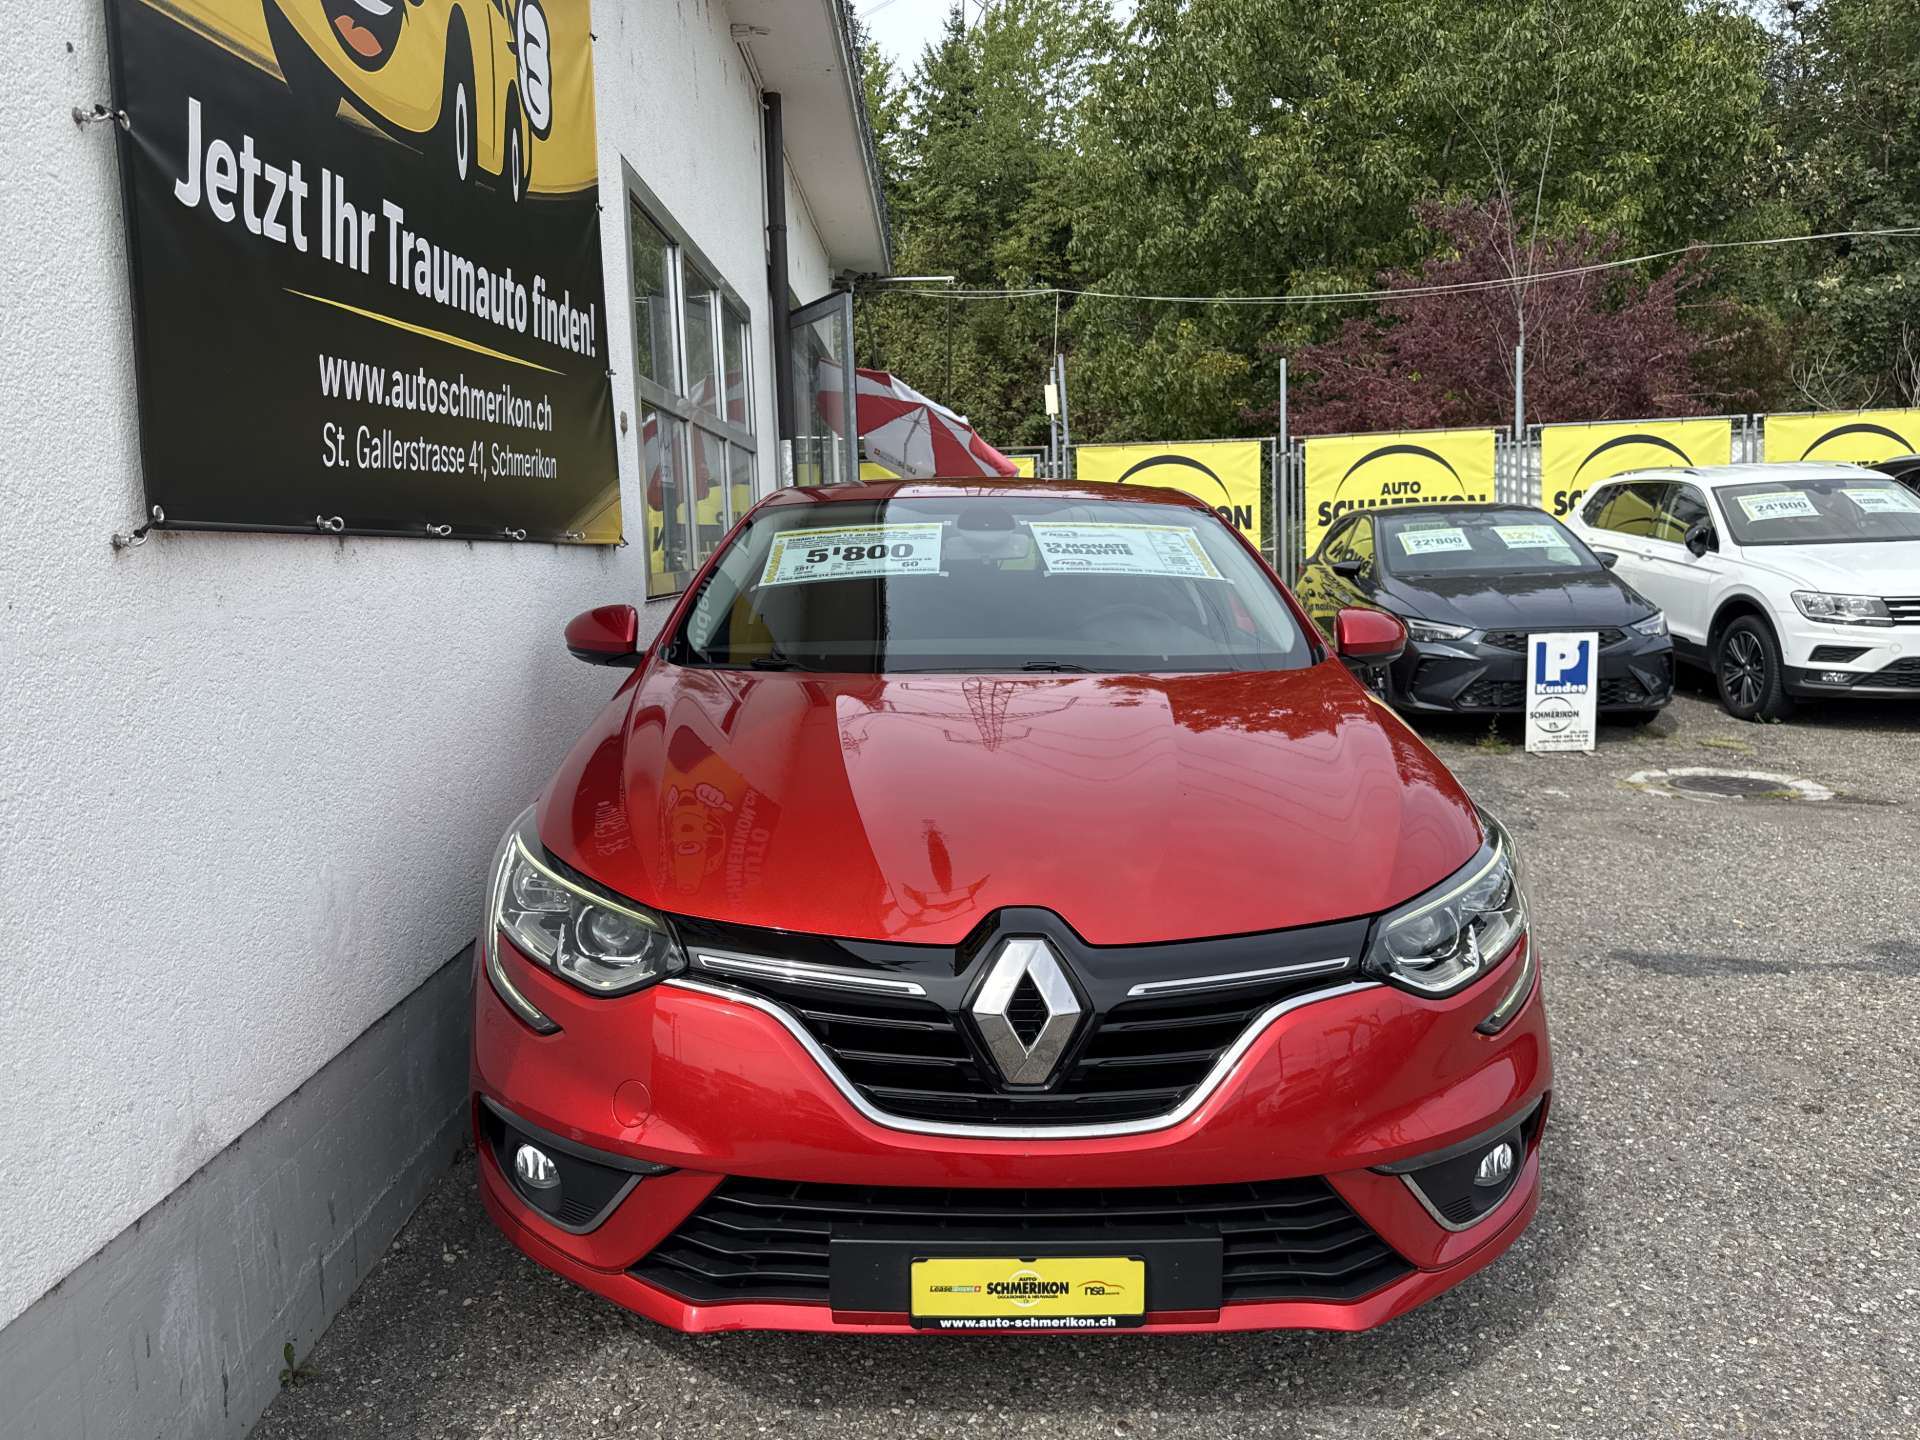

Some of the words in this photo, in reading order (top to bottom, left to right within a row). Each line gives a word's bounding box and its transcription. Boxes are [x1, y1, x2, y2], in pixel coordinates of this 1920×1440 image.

[174, 97, 309, 252] Jetzt
[321, 168, 375, 275] Ihr
[382, 199, 527, 333] Traumauto
[532, 274, 596, 358] finden!
[318, 353, 553, 432] www.autoschmerikon.ch
[322, 423, 350, 468] St.
[356, 429, 466, 474] Gallerstrasse
[468, 444, 488, 483] 41,
[491, 446, 557, 480] Schmerikon
[1381, 481, 1421, 496] AUTO
[1755, 501, 1808, 512] 24'800
[1412, 537, 1463, 547] 22'800
[805, 543, 914, 564] 5'800
[1047, 548, 1134, 556] GARANTIE
[1545, 641, 1581, 682] P
[1536, 683, 1588, 694] Kunden
[1529, 711, 1580, 720] SCHMERIKON
[986, 1281, 1069, 1295] SCHMERIKON
[1084, 1286, 1105, 1296] nsa
[940, 1318, 1117, 1329] www.auto-schmerikon.ch
